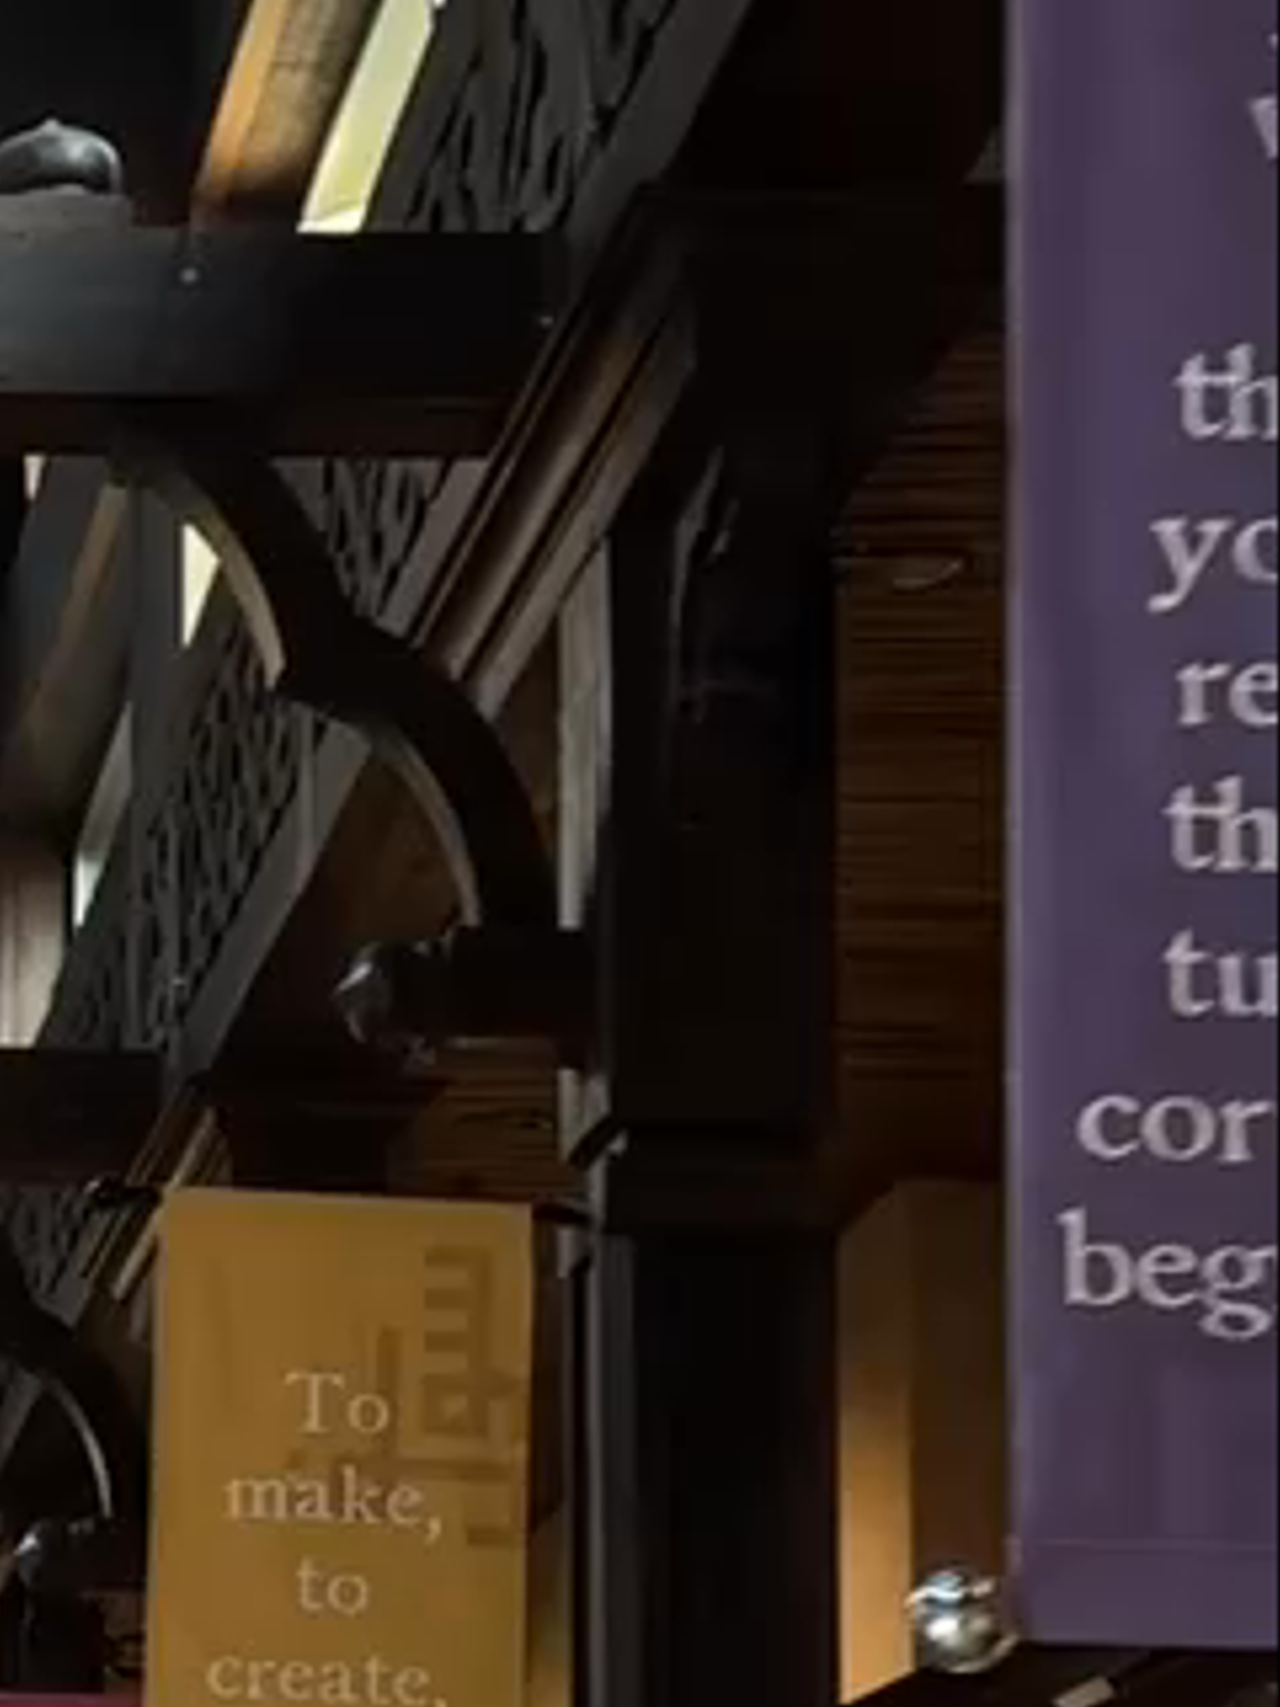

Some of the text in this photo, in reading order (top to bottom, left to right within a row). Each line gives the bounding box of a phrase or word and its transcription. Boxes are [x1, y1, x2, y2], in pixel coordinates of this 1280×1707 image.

[1056, 1207, 1277, 1340] beg
[285, 1370, 391, 1434] To
[225, 1465, 443, 1544] make,
[296, 1556, 369, 1615] to
